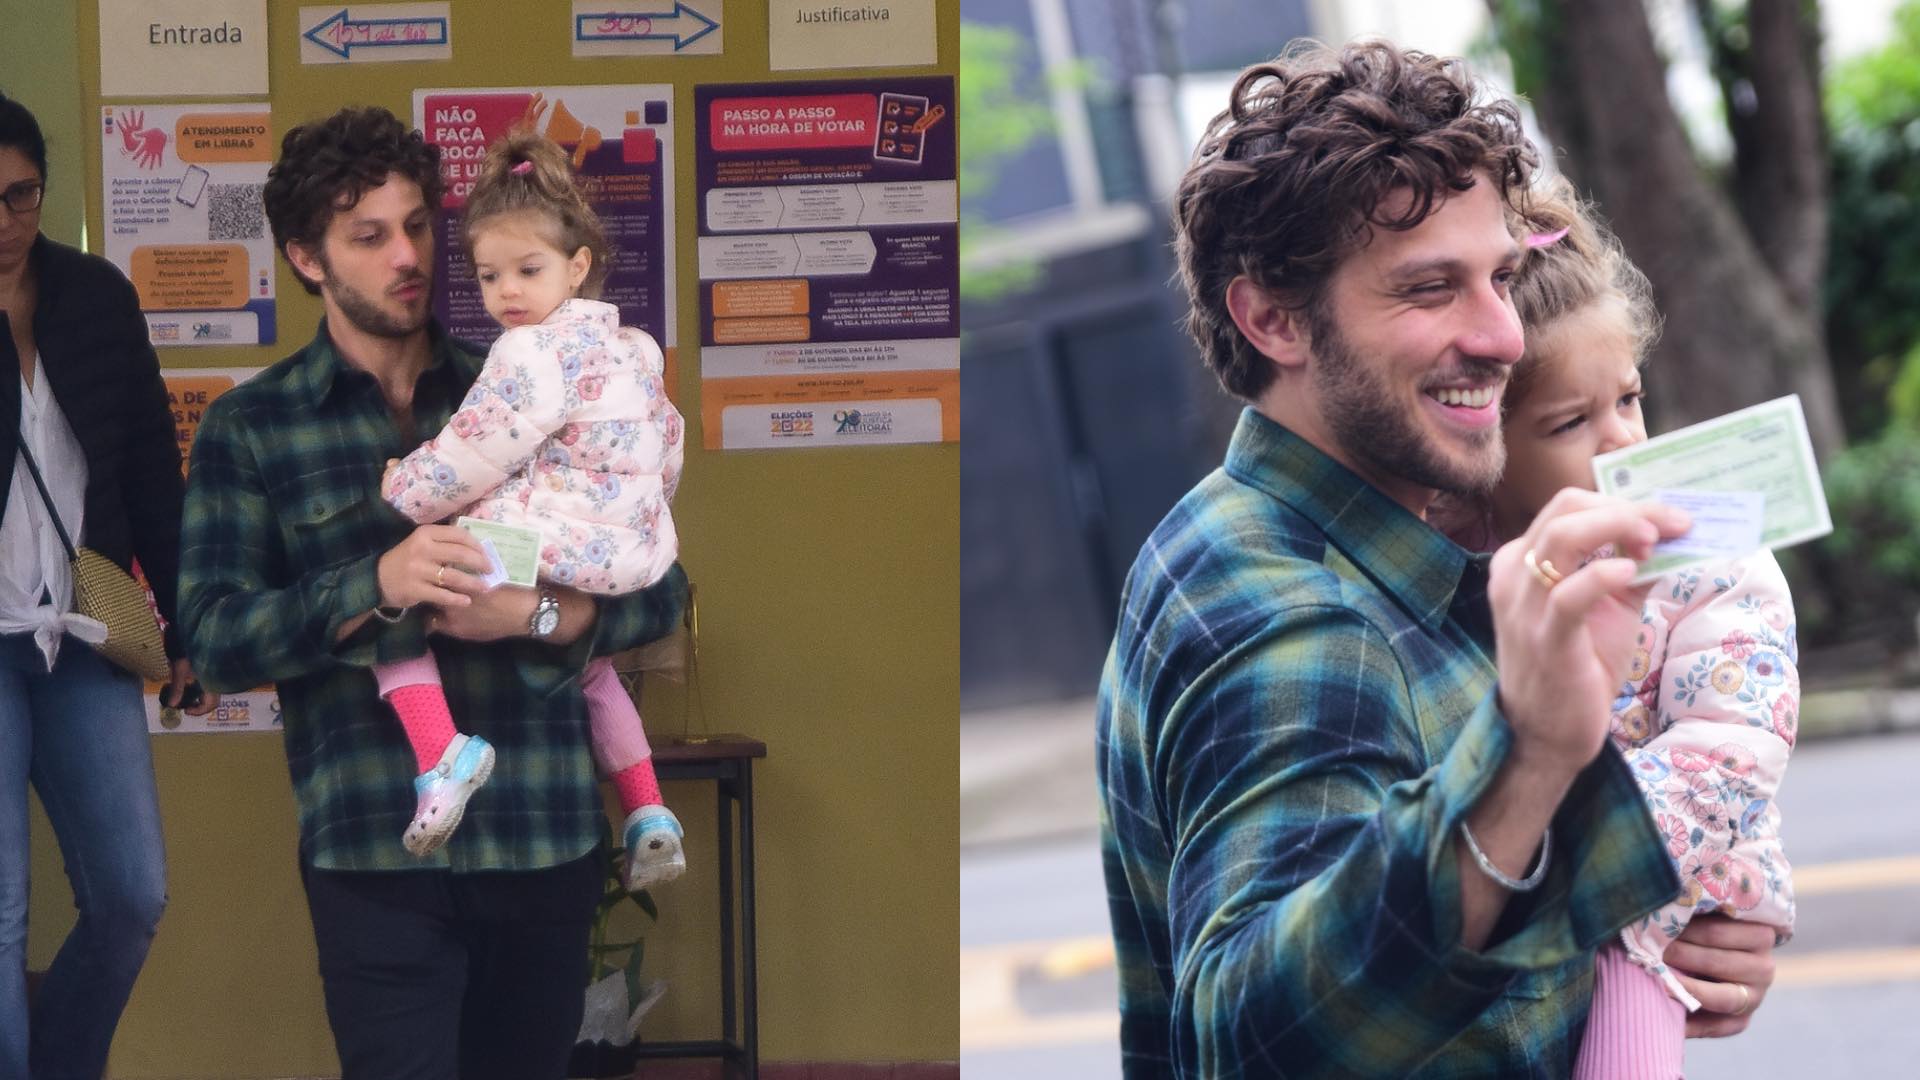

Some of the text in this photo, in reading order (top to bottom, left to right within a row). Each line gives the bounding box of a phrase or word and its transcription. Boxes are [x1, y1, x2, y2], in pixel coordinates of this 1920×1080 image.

[796, 6, 890, 24] Justificativa
[149, 21, 243, 45] Entrada
[435, 105, 477, 123] NÃO
[724, 107, 836, 121] PASSO A PASSO
[182, 125, 266, 137] ATENDIMENTO
[724, 120, 866, 136] NA HORA DE VOTAR
[435, 127, 485, 143] FAÇA
[194, 139, 256, 149] EM LIBRAS
[824, 171, 856, 179] VOTAÇÃO
[112, 198, 131, 206] para
[183, 391, 208, 404] DE
[771, 410, 813, 420] ELEIÇÕES
